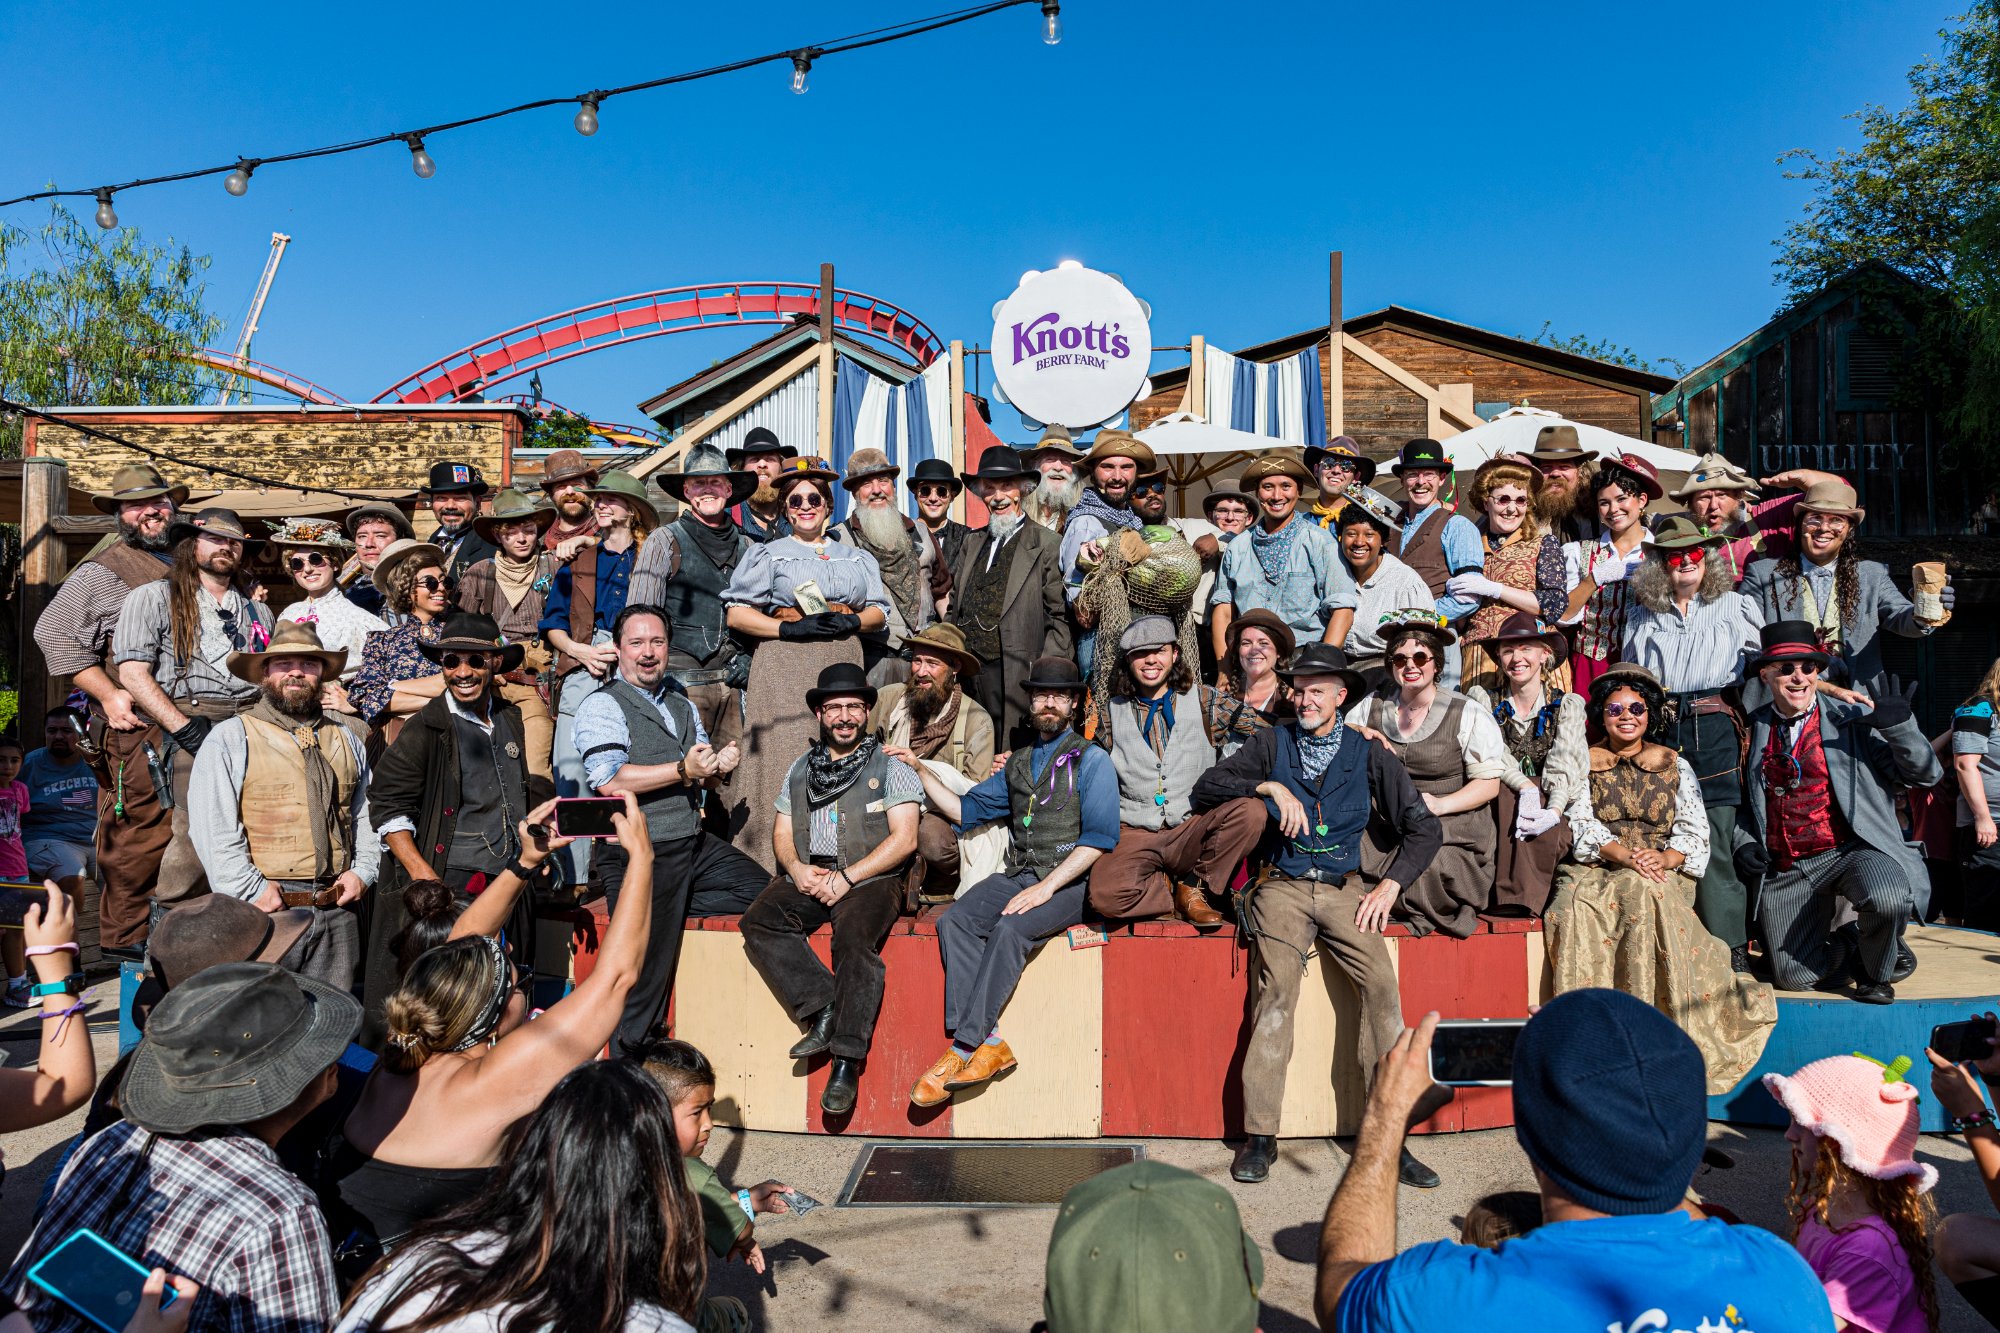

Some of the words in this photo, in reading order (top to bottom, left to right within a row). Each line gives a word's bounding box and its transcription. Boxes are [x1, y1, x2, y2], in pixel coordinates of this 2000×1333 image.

[1011, 312, 1130, 365] Knott's
[1036, 354, 1073, 371] BERRY
[1074, 354, 1106, 370] FARM
[1758, 443, 1914, 472] UTILITY
[43, 776, 98, 796] SKECHER
